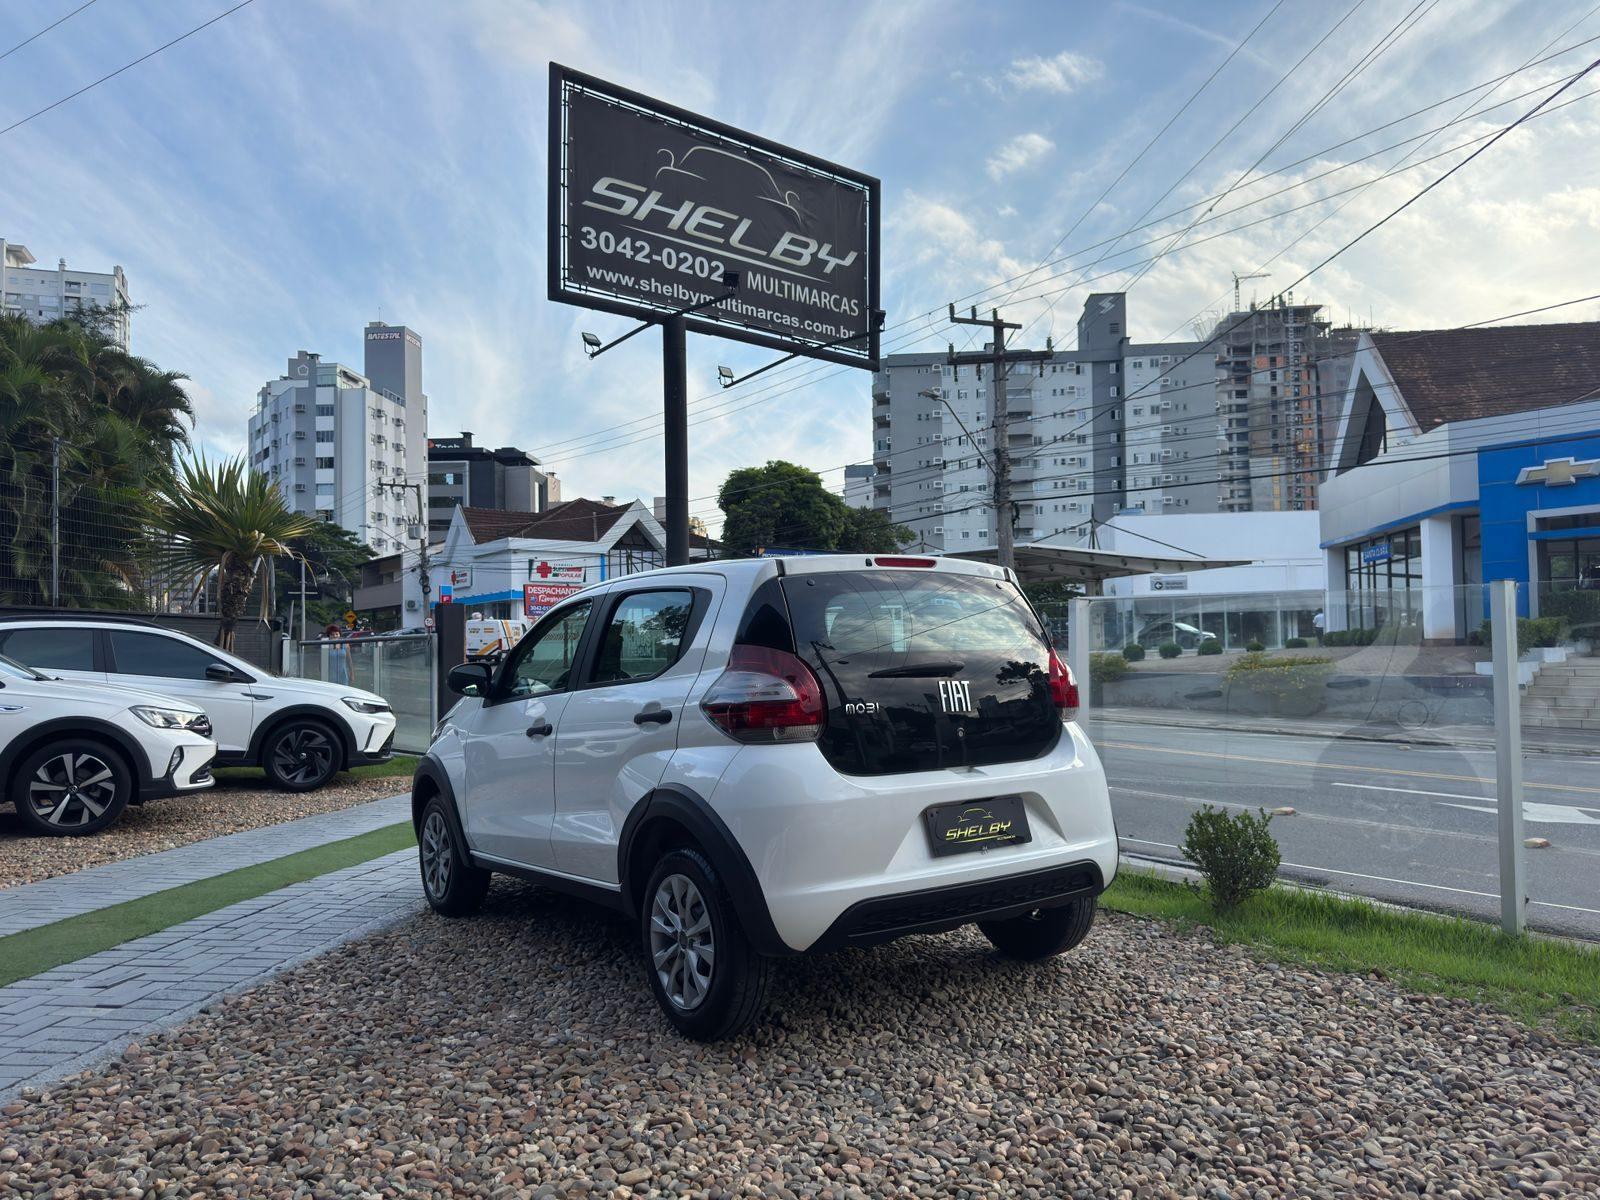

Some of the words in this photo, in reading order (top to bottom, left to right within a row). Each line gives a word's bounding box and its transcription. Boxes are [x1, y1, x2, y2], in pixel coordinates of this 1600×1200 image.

[582, 176, 858, 273] SHELBY
[581, 226, 725, 283] 3042-0202
[586, 265, 856, 339] www.shelbymultimarcas.com.br
[747, 271, 859, 316] MULTIMARCAS
[938, 680, 972, 713] FIAT
[945, 820, 1012, 841] SHELBY
